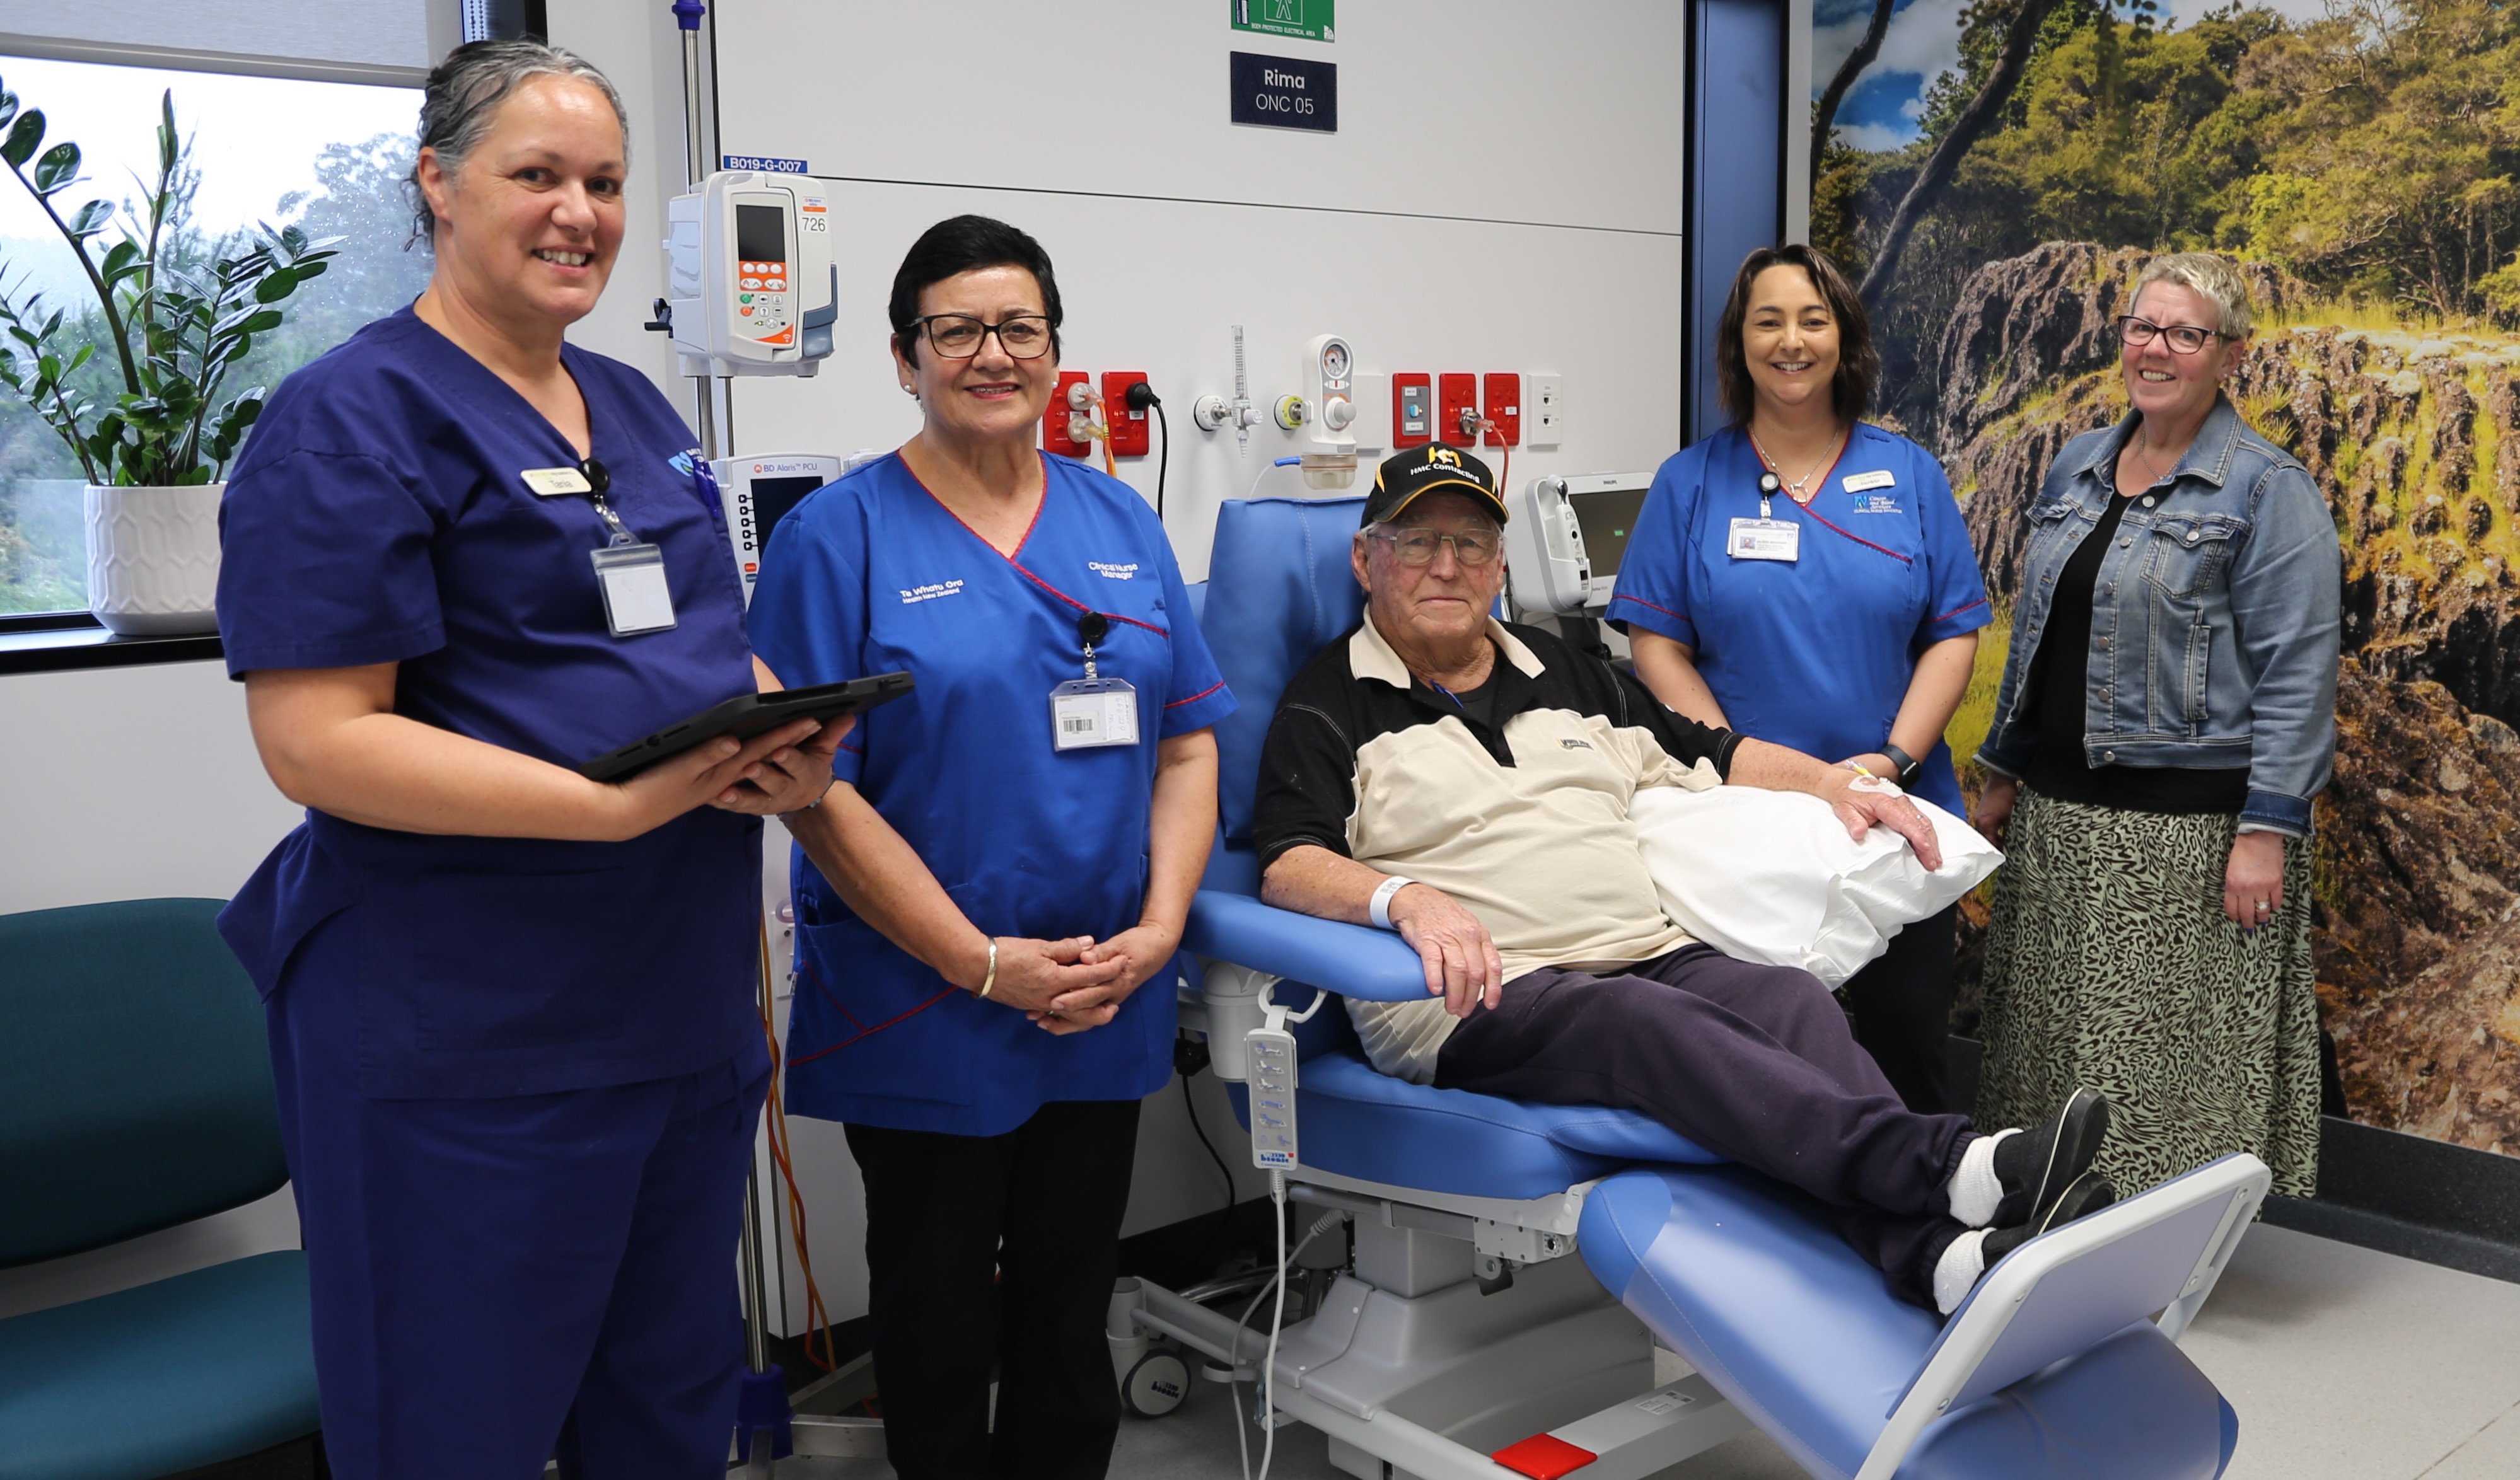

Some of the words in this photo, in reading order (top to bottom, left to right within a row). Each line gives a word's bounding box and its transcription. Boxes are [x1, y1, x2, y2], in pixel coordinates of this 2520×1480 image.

[1264, 69, 1304, 89] Rima
[1256, 93, 1290, 112] ONC
[1295, 97, 1313, 115] 05
[730, 157, 801, 172] B019-G-007
[802, 217, 825, 232] 726
[1410, 464, 1431, 475] HMC
[1432, 463, 1480, 484] Contracting
[1088, 562, 1115, 571] Clinical
[1115, 564, 1139, 572] Nurse
[1100, 570, 1134, 580] Manager
[902, 596, 922, 604] Health
[936, 587, 960, 598] Zealand
[912, 584, 944, 596] Whatu
[945, 579, 964, 589] Ora
